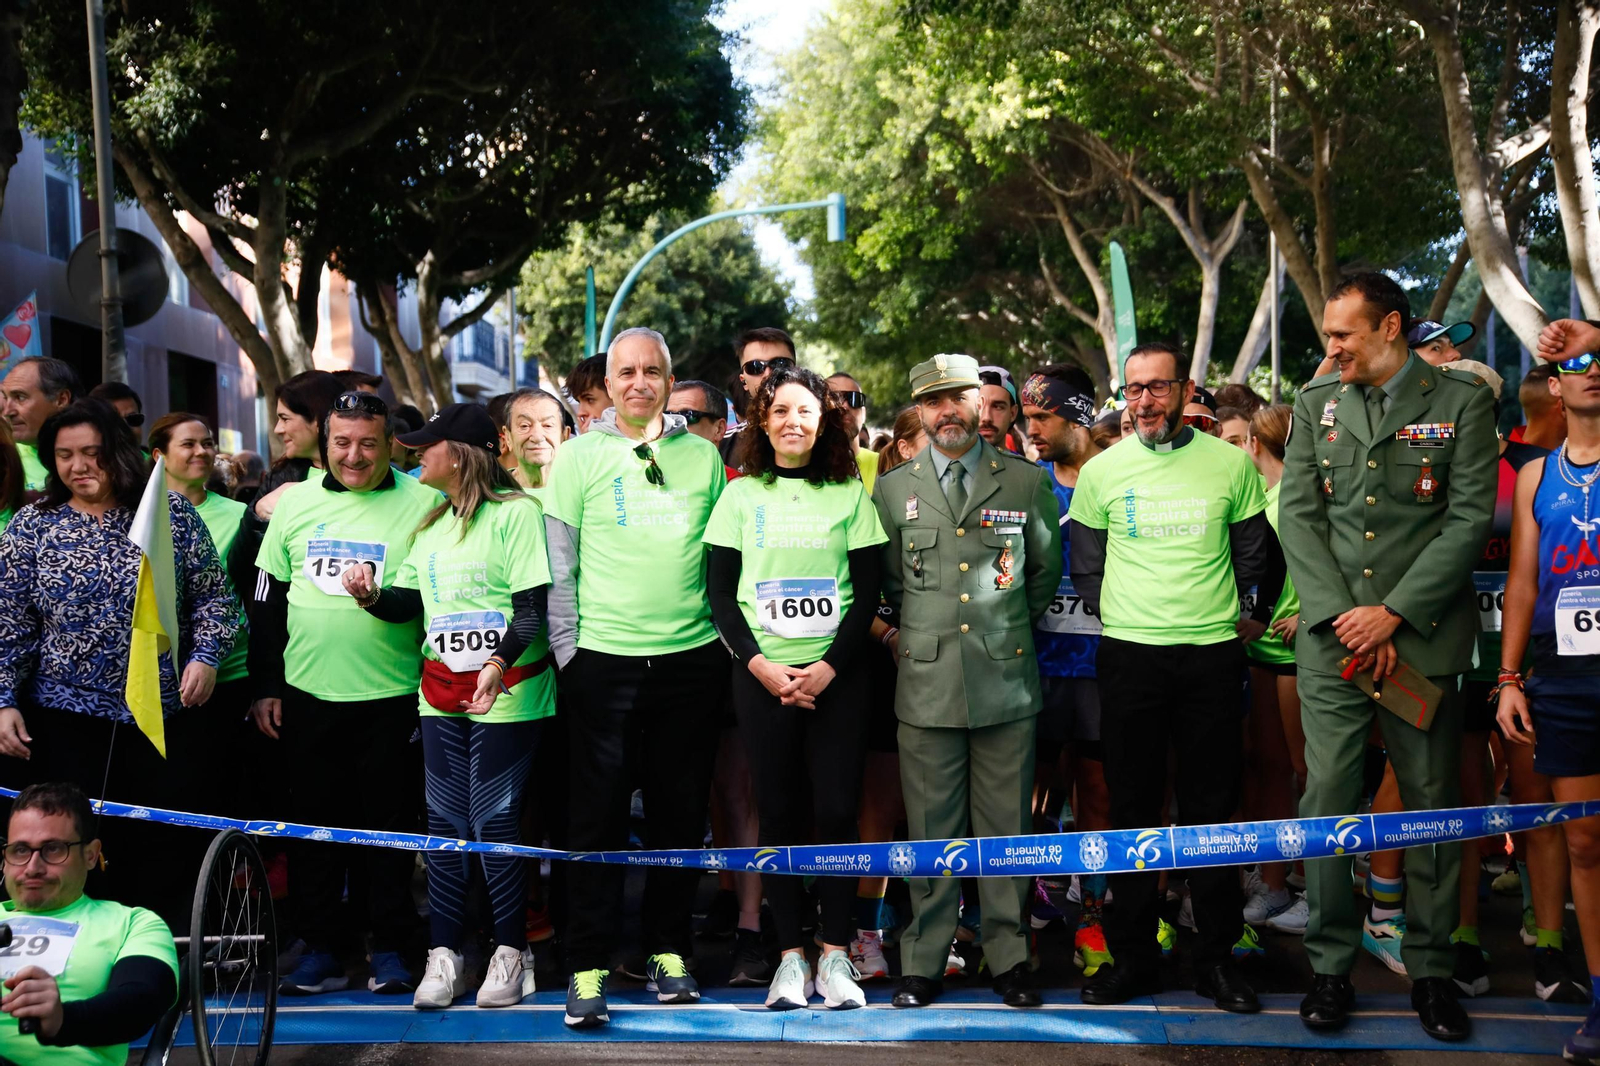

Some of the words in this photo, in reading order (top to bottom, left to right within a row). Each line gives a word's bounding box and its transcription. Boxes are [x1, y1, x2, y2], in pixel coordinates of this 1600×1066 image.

[611, 476, 627, 527] ALMERÍA
[629, 500, 673, 510] contra
[677, 496, 690, 508] el
[1139, 500, 1155, 510] En
[1159, 497, 1207, 508] marcha
[630, 511, 689, 526] cáncer
[1122, 487, 1138, 538] ALMERÍA
[1140, 508, 1190, 522] contra
[1193, 506, 1208, 519] el
[768, 523, 813, 532] contra
[817, 522, 830, 532] el
[1141, 522, 1208, 538] cáncer
[767, 534, 829, 549] cáncer
[1551, 534, 1600, 575] GA
[474, 570, 488, 582] el
[765, 597, 833, 620] 1600
[434, 629, 501, 654] 1509
[1448, 819, 1463, 829] de
[1243, 833, 1258, 844] de
[1384, 827, 1463, 843] Ayuntamiento
[1048, 845, 1062, 855] de
[1182, 841, 1258, 857] Ayuntamiento
[857, 854, 871, 864] de
[989, 852, 1062, 867] Ayuntamiento
[799, 862, 871, 872] Ayuntamiento
